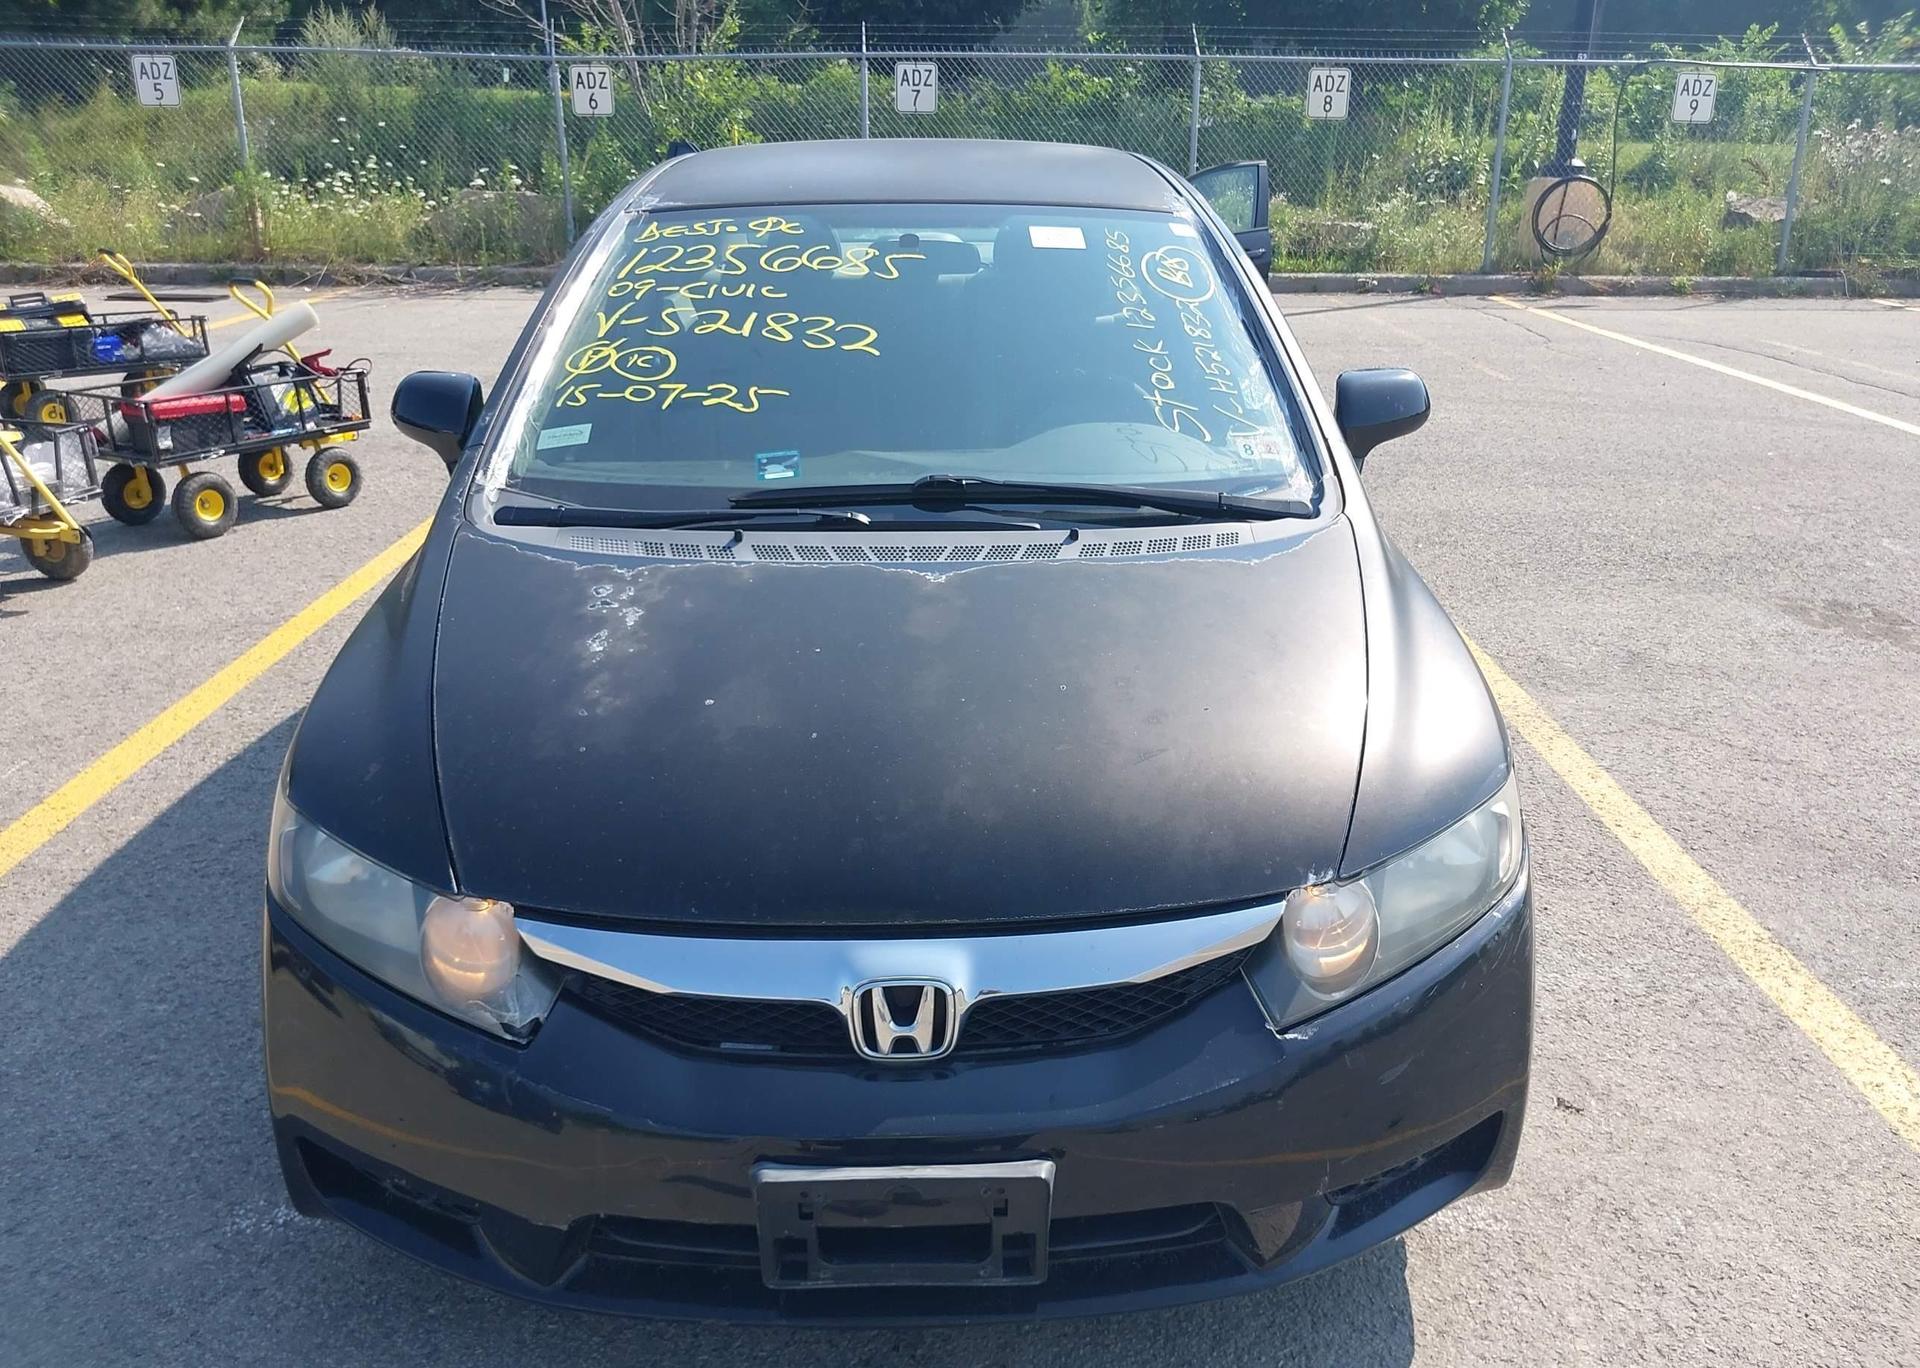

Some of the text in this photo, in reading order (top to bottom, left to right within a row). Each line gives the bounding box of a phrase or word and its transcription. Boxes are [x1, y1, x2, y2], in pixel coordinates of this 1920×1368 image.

[140, 62, 172, 80] ADZ
[900, 69, 933, 87] ADZ
[576, 72, 608, 90] ADZ
[1312, 75, 1346, 93] ADZ
[1680, 79, 1713, 97] ADZ
[153, 83, 164, 101] 5
[589, 92, 599, 110] 6
[911, 89, 921, 107] 7
[1323, 95, 1333, 113] 8
[1689, 99, 1699, 116] 9
[617, 244, 927, 280] 12356685
[1104, 226, 1156, 330] 12356685
